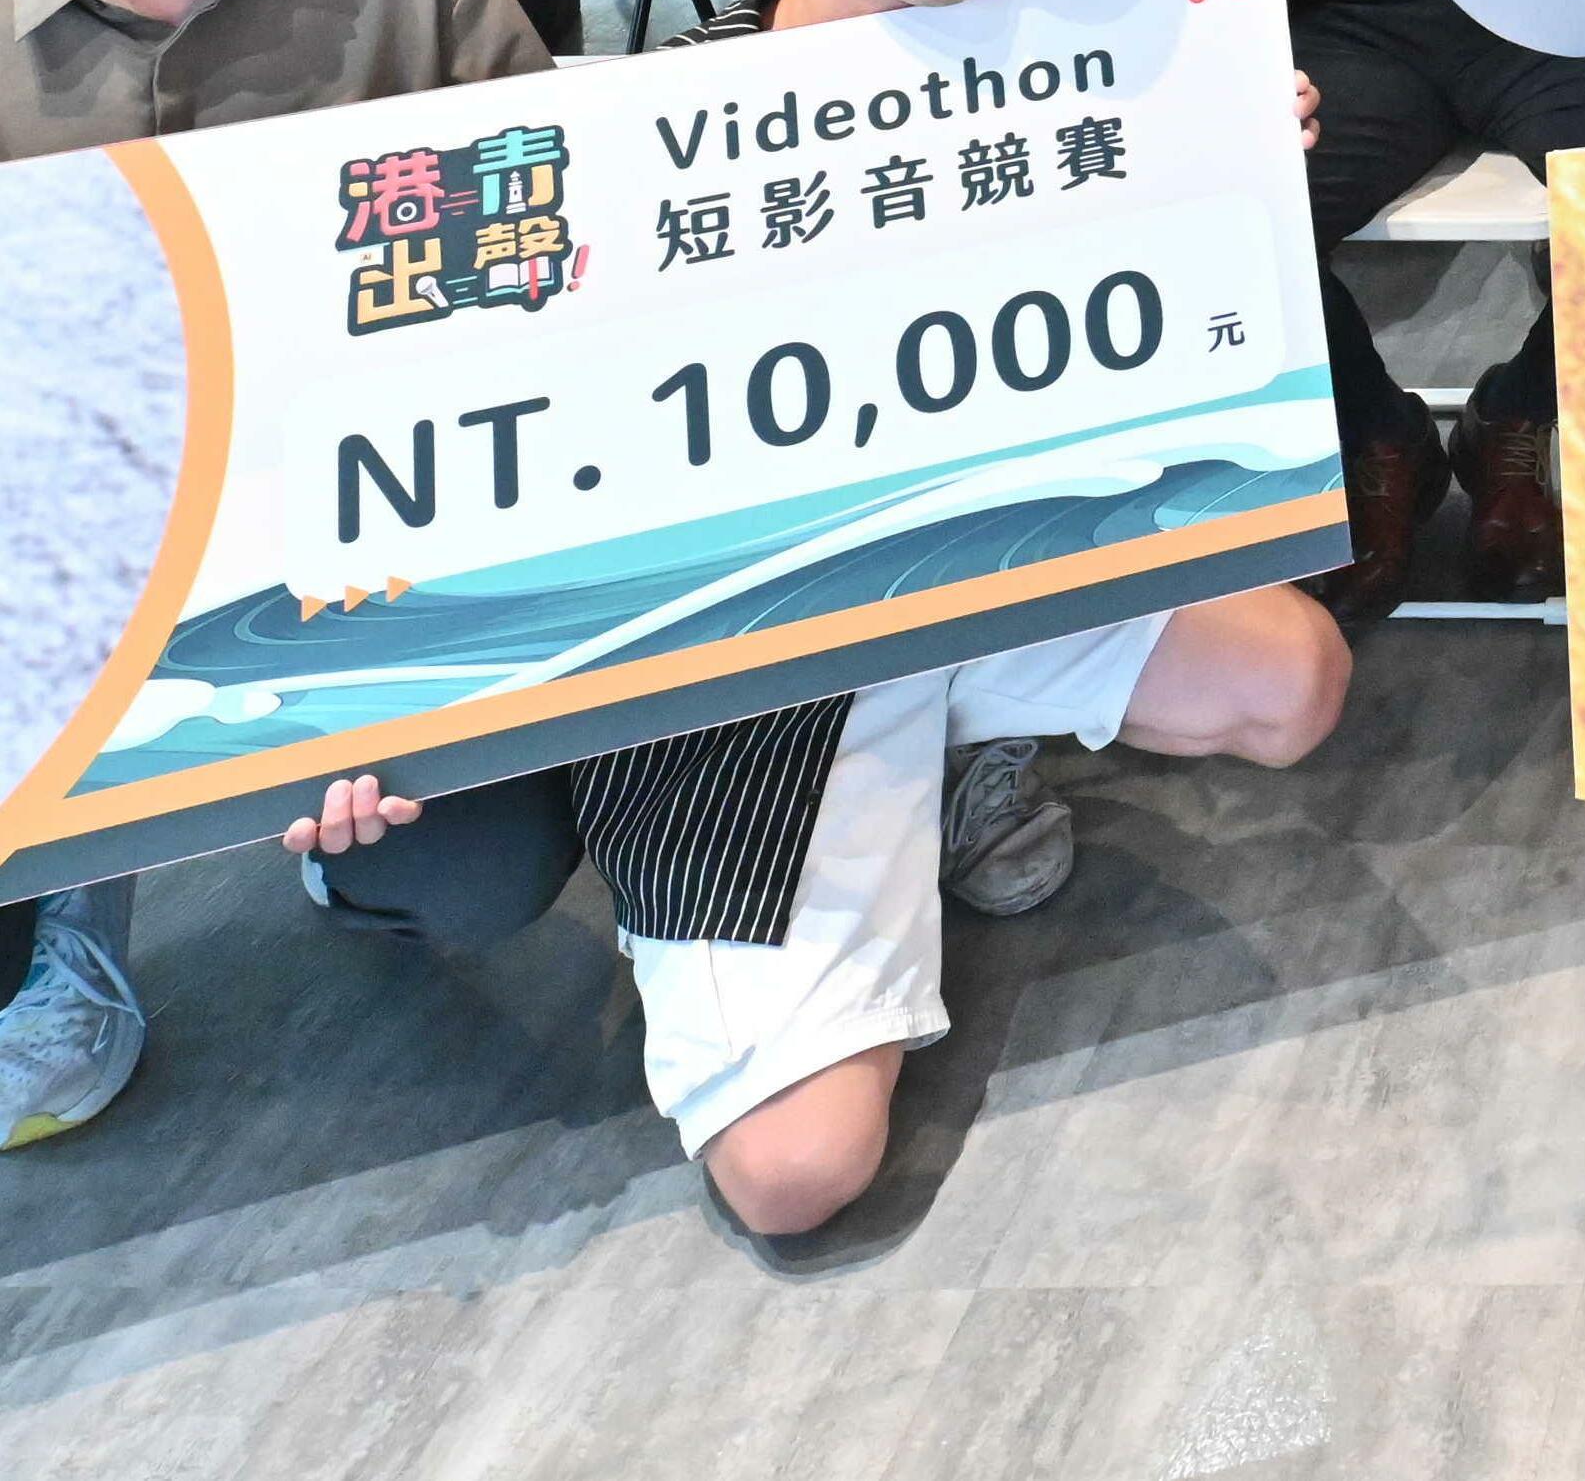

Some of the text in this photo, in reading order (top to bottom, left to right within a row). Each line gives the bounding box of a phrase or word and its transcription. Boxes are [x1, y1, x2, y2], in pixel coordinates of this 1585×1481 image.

[657, 51, 1115, 169] Videothon
[657, 117, 1127, 272] 短影音競賽
[339, 271, 1245, 543] NT. 10,000 元
